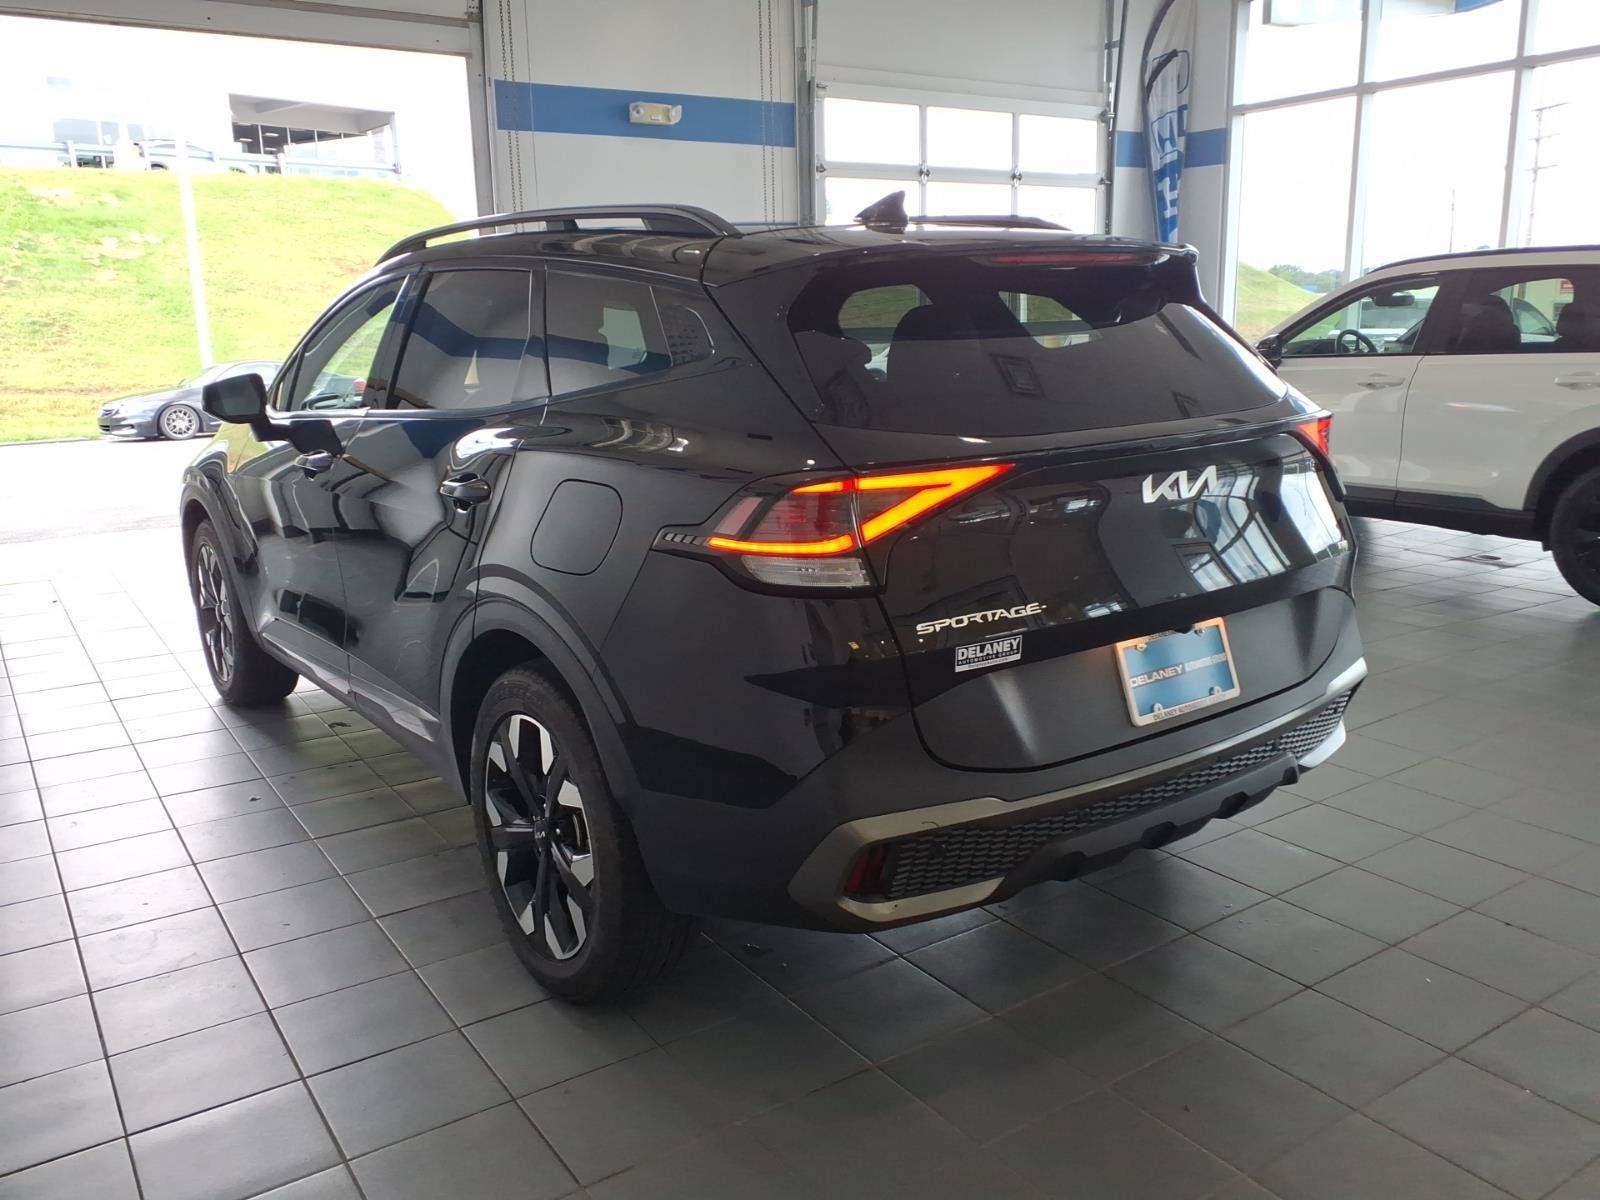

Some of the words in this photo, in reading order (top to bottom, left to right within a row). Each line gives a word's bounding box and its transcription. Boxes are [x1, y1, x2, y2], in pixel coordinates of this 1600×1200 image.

[1142, 464, 1217, 504] KIA
[916, 602, 1042, 635] SPORTAGE
[957, 637, 1020, 661] DELANEY
[1129, 664, 1183, 688] DELANEY
